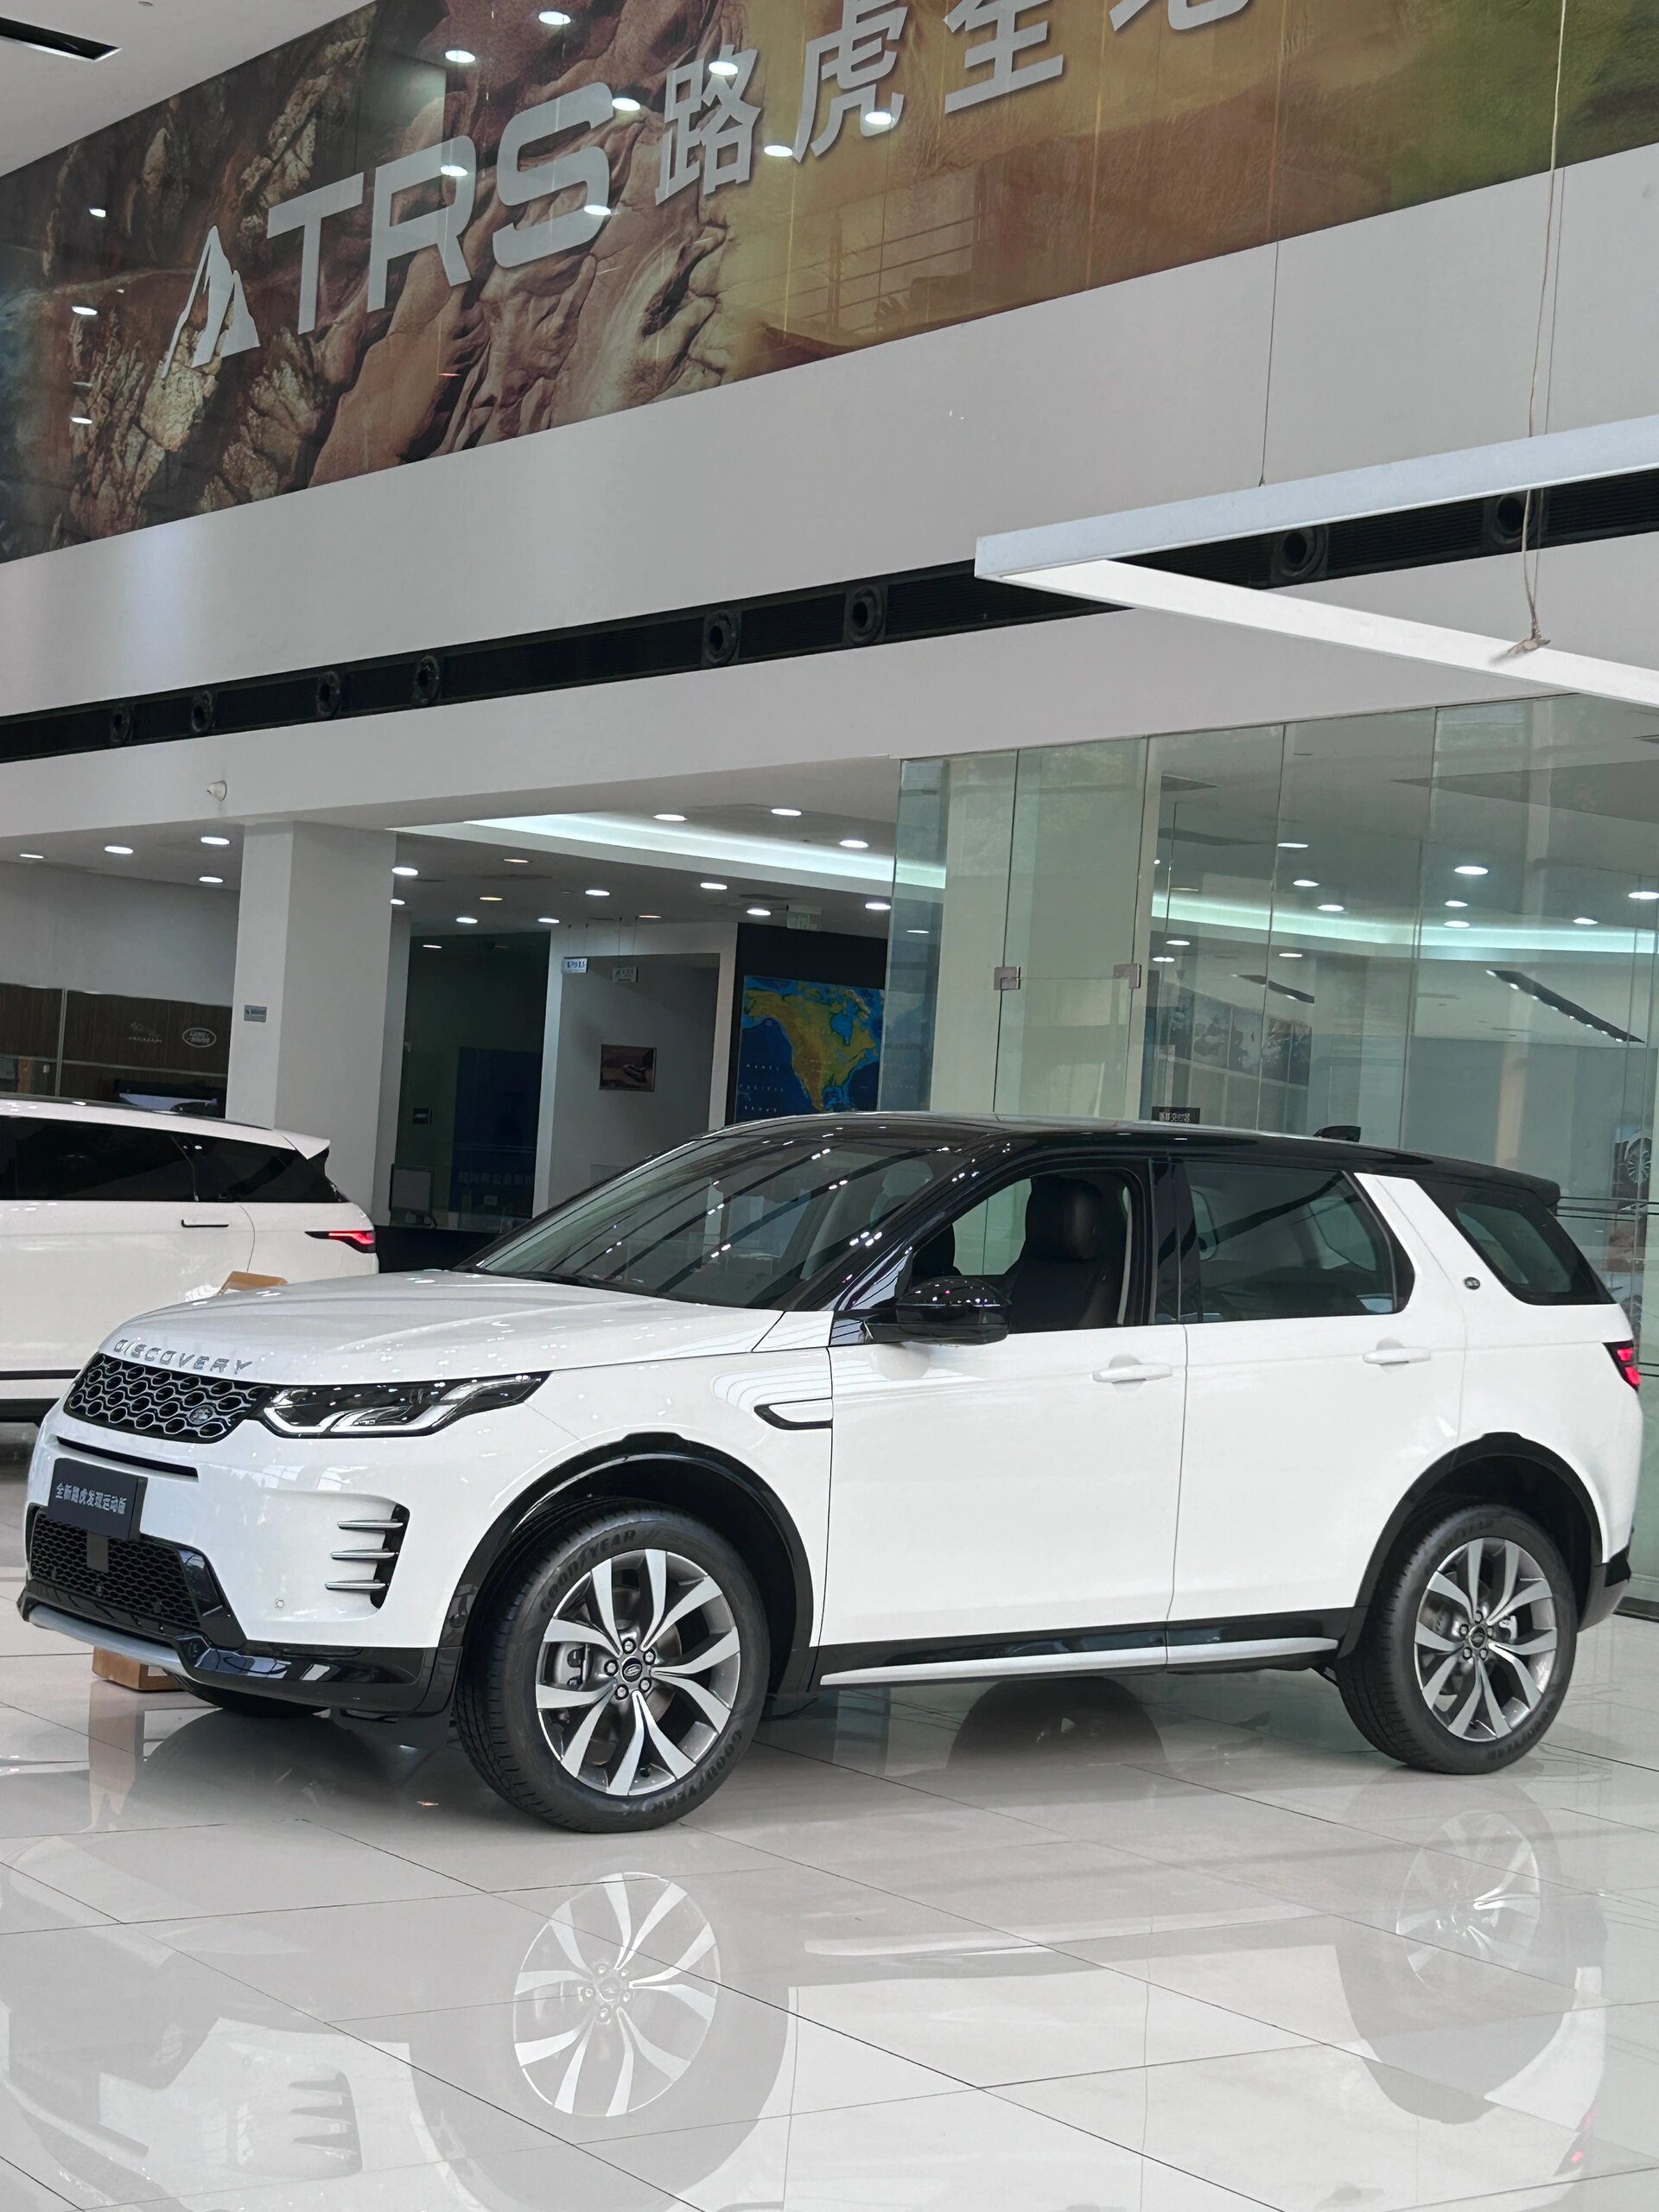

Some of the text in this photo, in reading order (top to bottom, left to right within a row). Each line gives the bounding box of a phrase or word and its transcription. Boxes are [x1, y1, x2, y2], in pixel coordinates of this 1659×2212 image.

[266, 0, 1250, 334] TRS 路虎全
[114, 1339, 252, 1375] DISCOVERY
[539, 1529, 636, 1612] GOODYEAR
